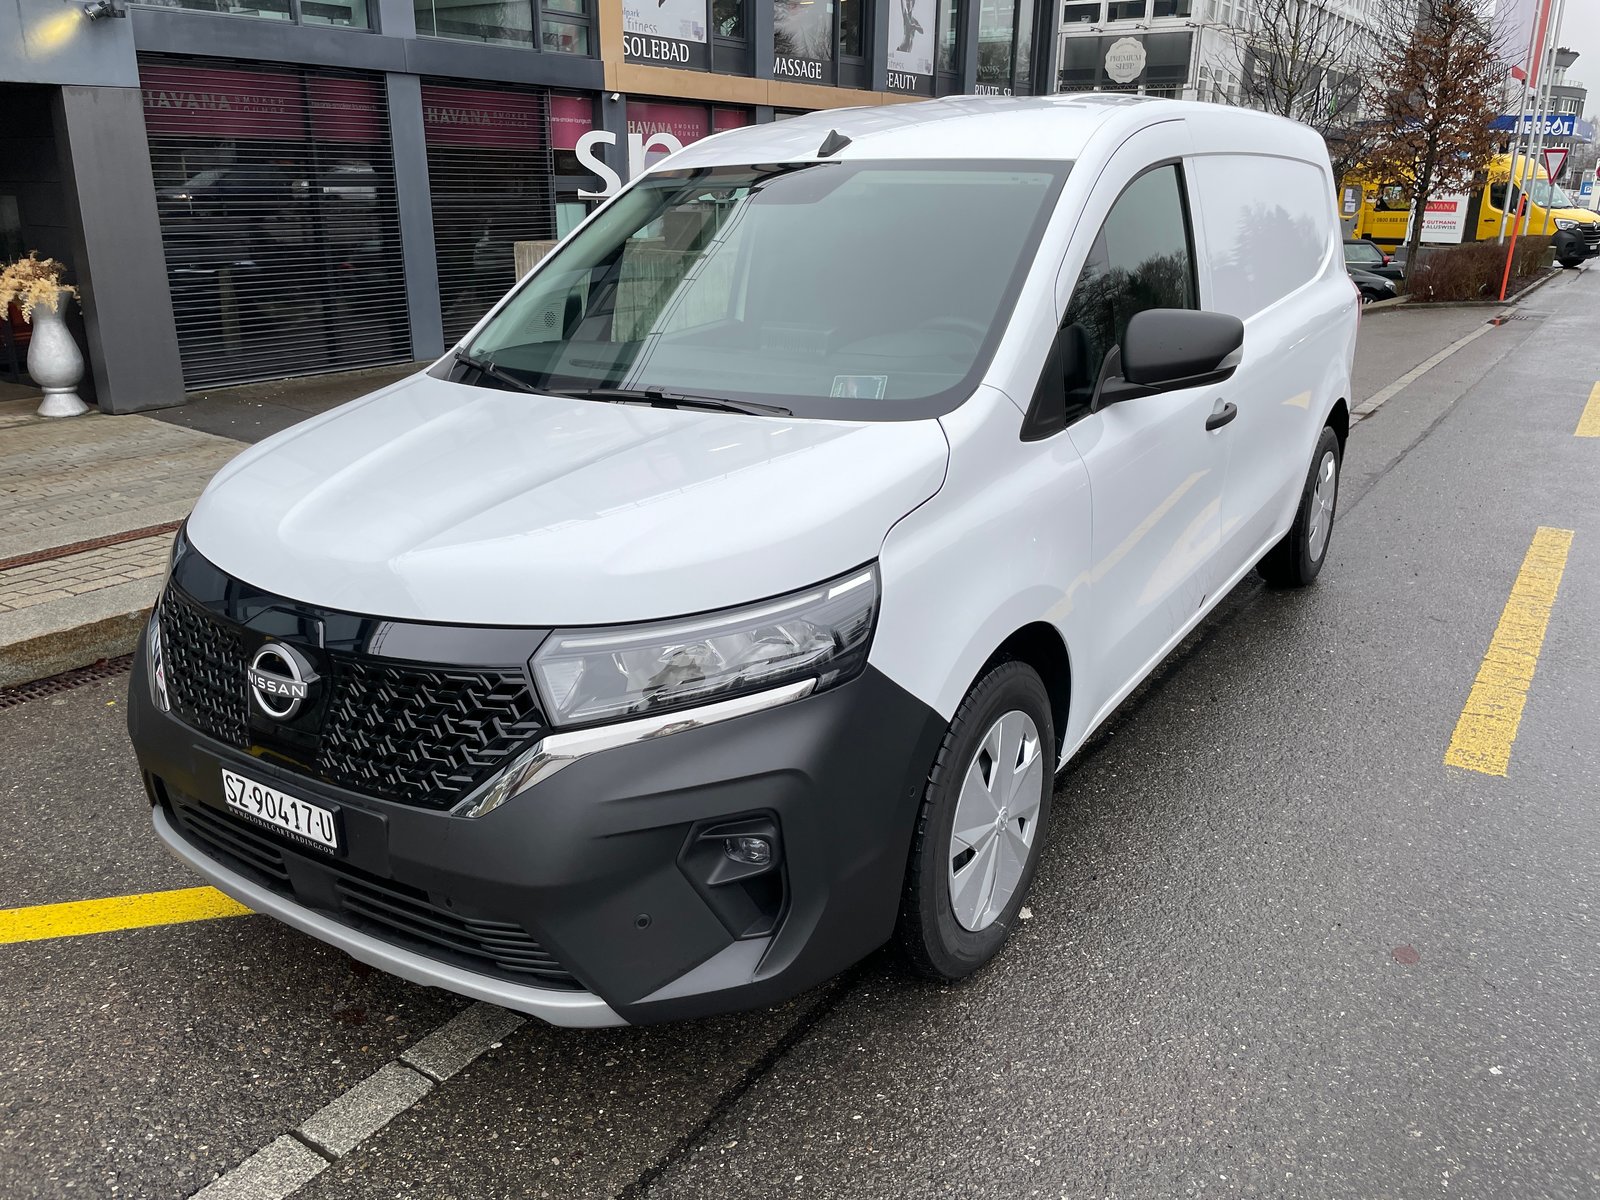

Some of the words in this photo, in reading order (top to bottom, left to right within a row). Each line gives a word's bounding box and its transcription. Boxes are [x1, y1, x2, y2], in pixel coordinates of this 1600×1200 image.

[628, 18, 658, 34] fitness
[623, 36, 690, 63] SOLEBAD
[886, 73, 917, 90] EAUTY
[975, 84, 1000, 96] RIVATE
[627, 120, 672, 135] HAVANA
[248, 670, 304, 697] NISSAN
